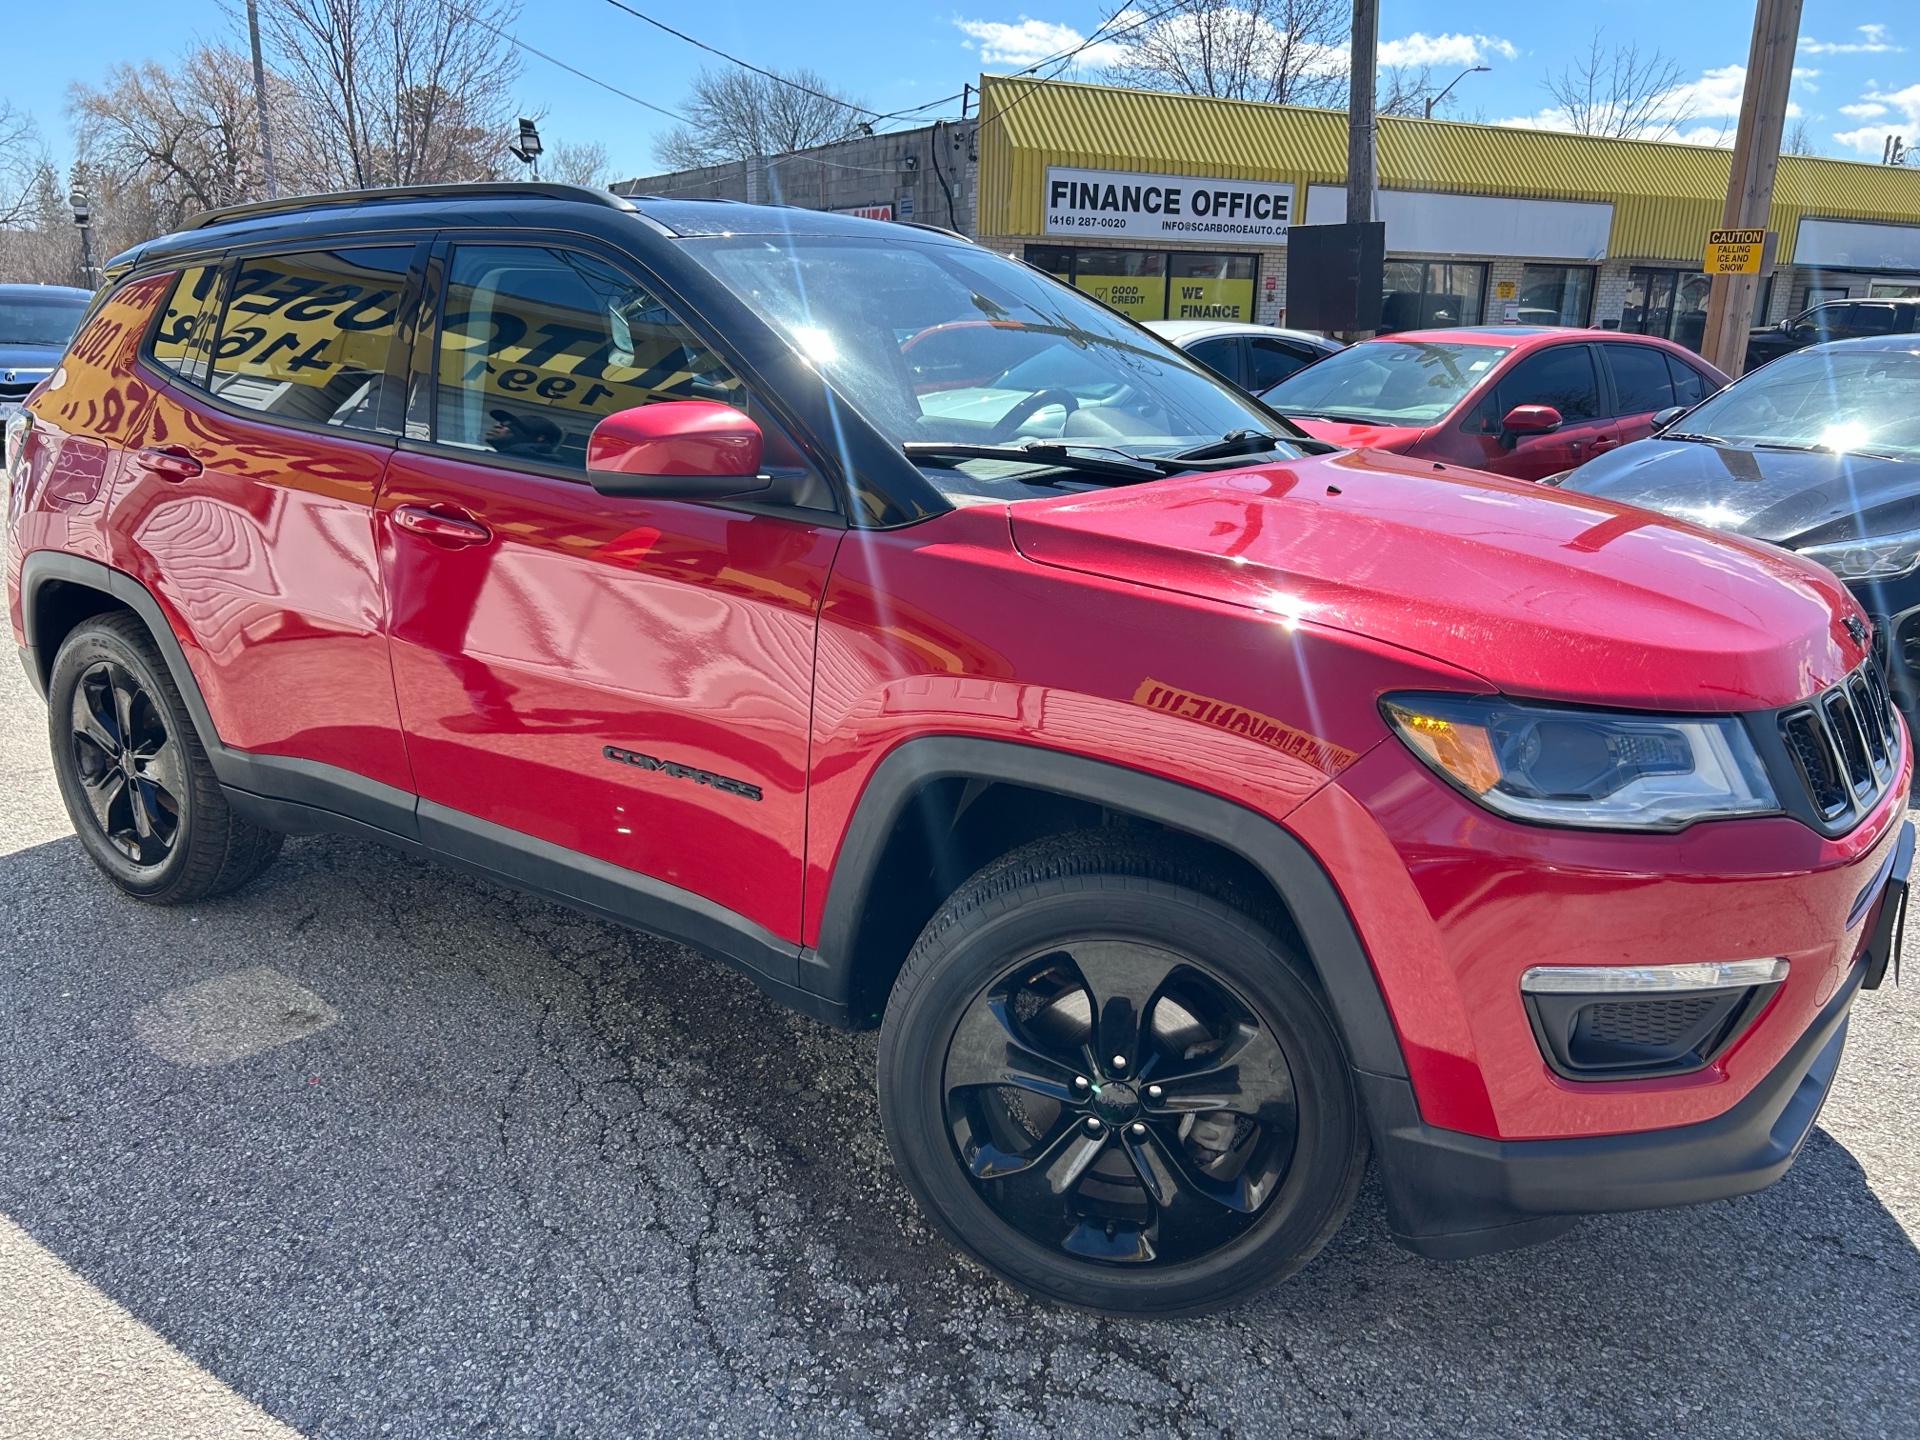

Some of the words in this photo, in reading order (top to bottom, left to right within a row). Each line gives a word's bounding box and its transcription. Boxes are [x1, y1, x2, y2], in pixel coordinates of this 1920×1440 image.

[1050, 180, 1181, 215] FINANCE
[1191, 189, 1289, 221] OFFICE
[1049, 215, 1075, 226] (416)
[1078, 216, 1126, 228] 287-0020
[1711, 231, 1761, 243] CAUTION
[1718, 245, 1751, 253] FALLING
[1716, 254, 1730, 262] ICE
[1731, 254, 1749, 262] AND
[1719, 263, 1744, 272] SNOW
[1111, 286, 1138, 295] GOOD
[1181, 287, 1203, 300] WE
[1111, 296, 1145, 305] CREDIT
[1180, 305, 1240, 318] FINANCE
[602, 745, 763, 801] COMPASS
